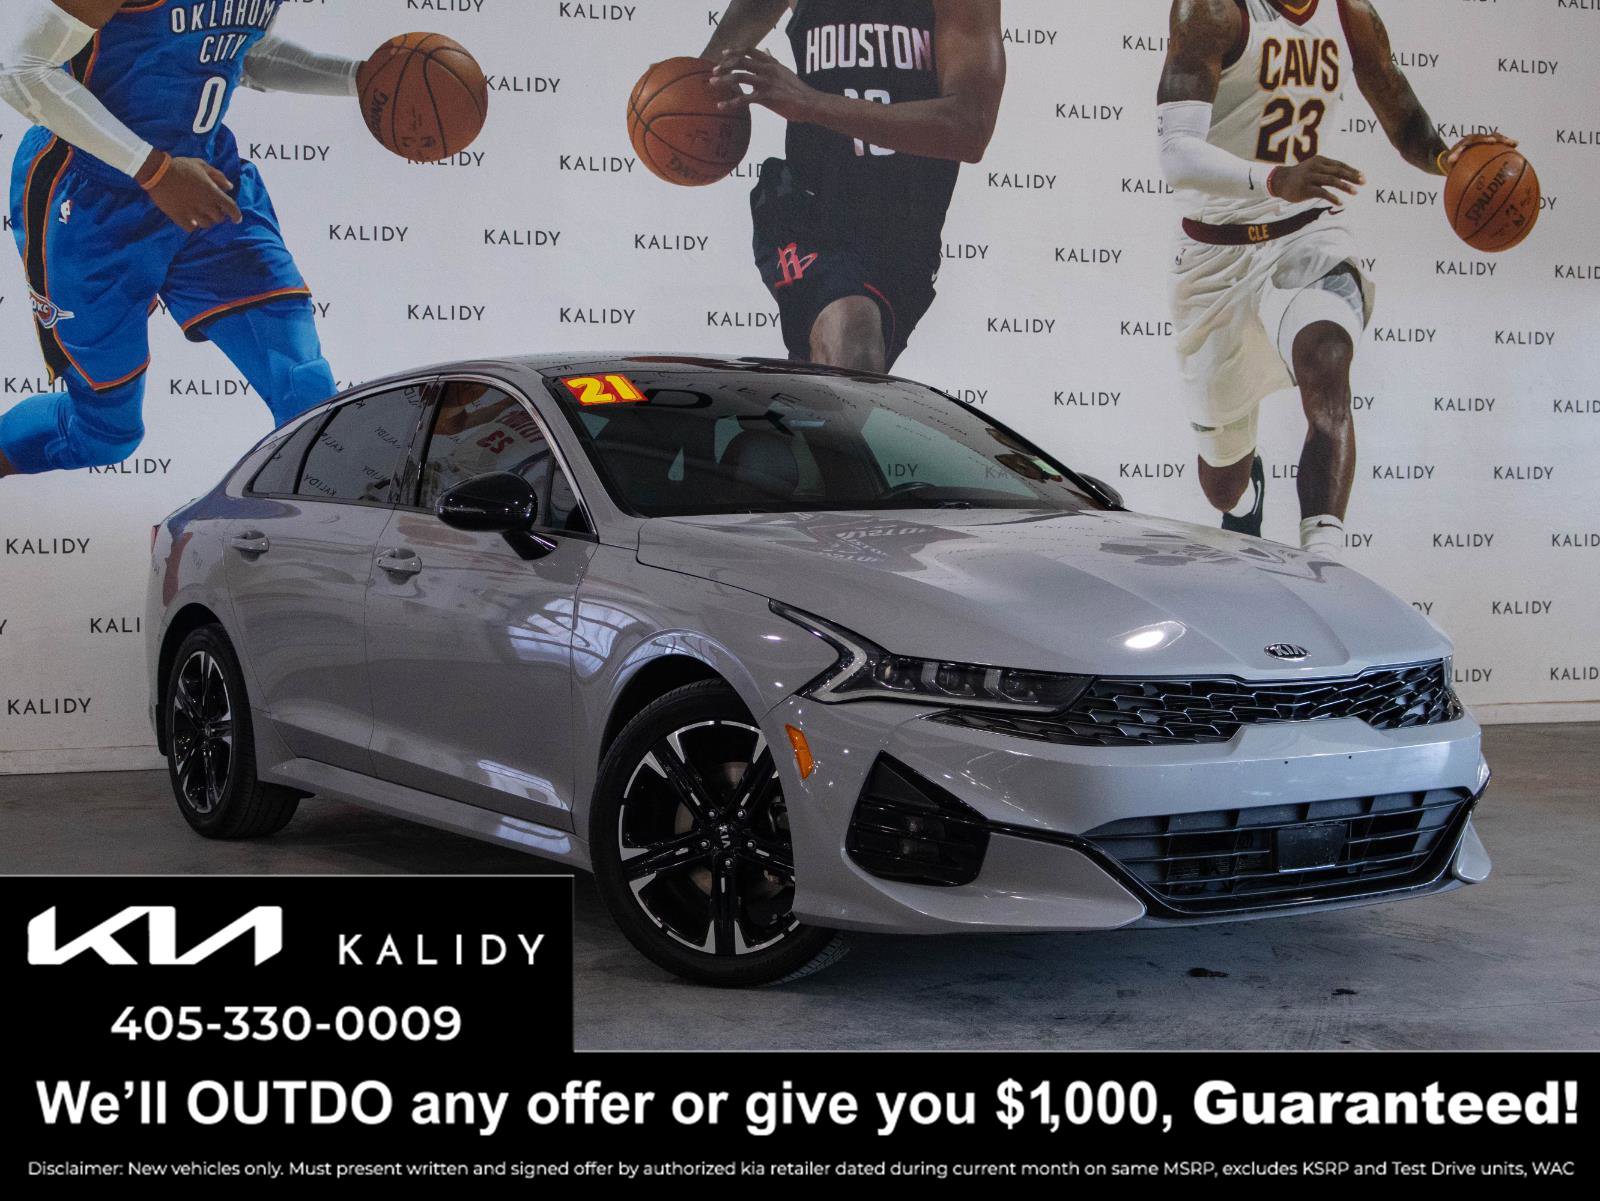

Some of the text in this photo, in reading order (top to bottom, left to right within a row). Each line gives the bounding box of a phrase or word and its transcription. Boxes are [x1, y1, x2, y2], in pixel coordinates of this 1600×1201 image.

[172, 0, 276, 33] OKLAHOM
[560, 2, 636, 21] KALIDY
[1002, 29, 1057, 46] ALIDY
[1123, 35, 1170, 51] KALI
[200, 34, 247, 63] CITY
[806, 23, 932, 74] HOUSTON
[1259, 38, 1339, 92] CAVS
[1391, 53, 1439, 67] ALIDY
[1498, 58, 1558, 75] KALIDY
[485, 76, 561, 93] KALIDY
[192, 76, 227, 134] 0
[1056, 104, 1123, 120] KALIDY
[1255, 97, 1325, 163] 23
[250, 144, 330, 161] KALIDY
[560, 155, 635, 172] KALIDY
[988, 173, 1056, 189] KALIDY
[1376, 190, 1437, 205] KALIDY
[330, 225, 408, 242] KALIDY
[484, 229, 561, 246] KALIDY
[1248, 225, 1268, 241] CLE
[634, 234, 708, 252] KALIDY
[939, 244, 989, 260] LIDY
[1055, 248, 1122, 264] KALIDY
[1436, 260, 1497, 276] KALIDY
[1555, 265, 1600, 279] KALID
[408, 304, 485, 321] KALIDY
[560, 307, 635, 325] KALIDY
[708, 312, 780, 327] KALIDY
[988, 318, 1056, 333] KALIDY
[1121, 322, 1172, 336] KALID
[1374, 328, 1436, 343] KALIDY
[1495, 331, 1555, 345] KALIDY
[170, 379, 251, 395] KALIDY
[567, 375, 640, 403] 21
[1054, 391, 1121, 407] KALIDY
[1434, 397, 1496, 412] KALIDY
[1554, 400, 1600, 414] KALID
[1119, 463, 1185, 479] KALIDY
[1373, 465, 1435, 480] KALIDY
[1494, 466, 1554, 480] KALIDY
[6, 538, 90, 555] KALIDY
[1345, 533, 1373, 548] IDY
[1433, 533, 1494, 548] KALIDY
[1552, 533, 1600, 547] KALID
[1492, 601, 1552, 615] KALIDY
[90, 617, 141, 634] KALI
[1275, 645, 1305, 656] KIA
[1455, 668, 1492, 682] LIDY
[1550, 667, 1600, 681] KALID
[8, 698, 92, 715] KALIDY
